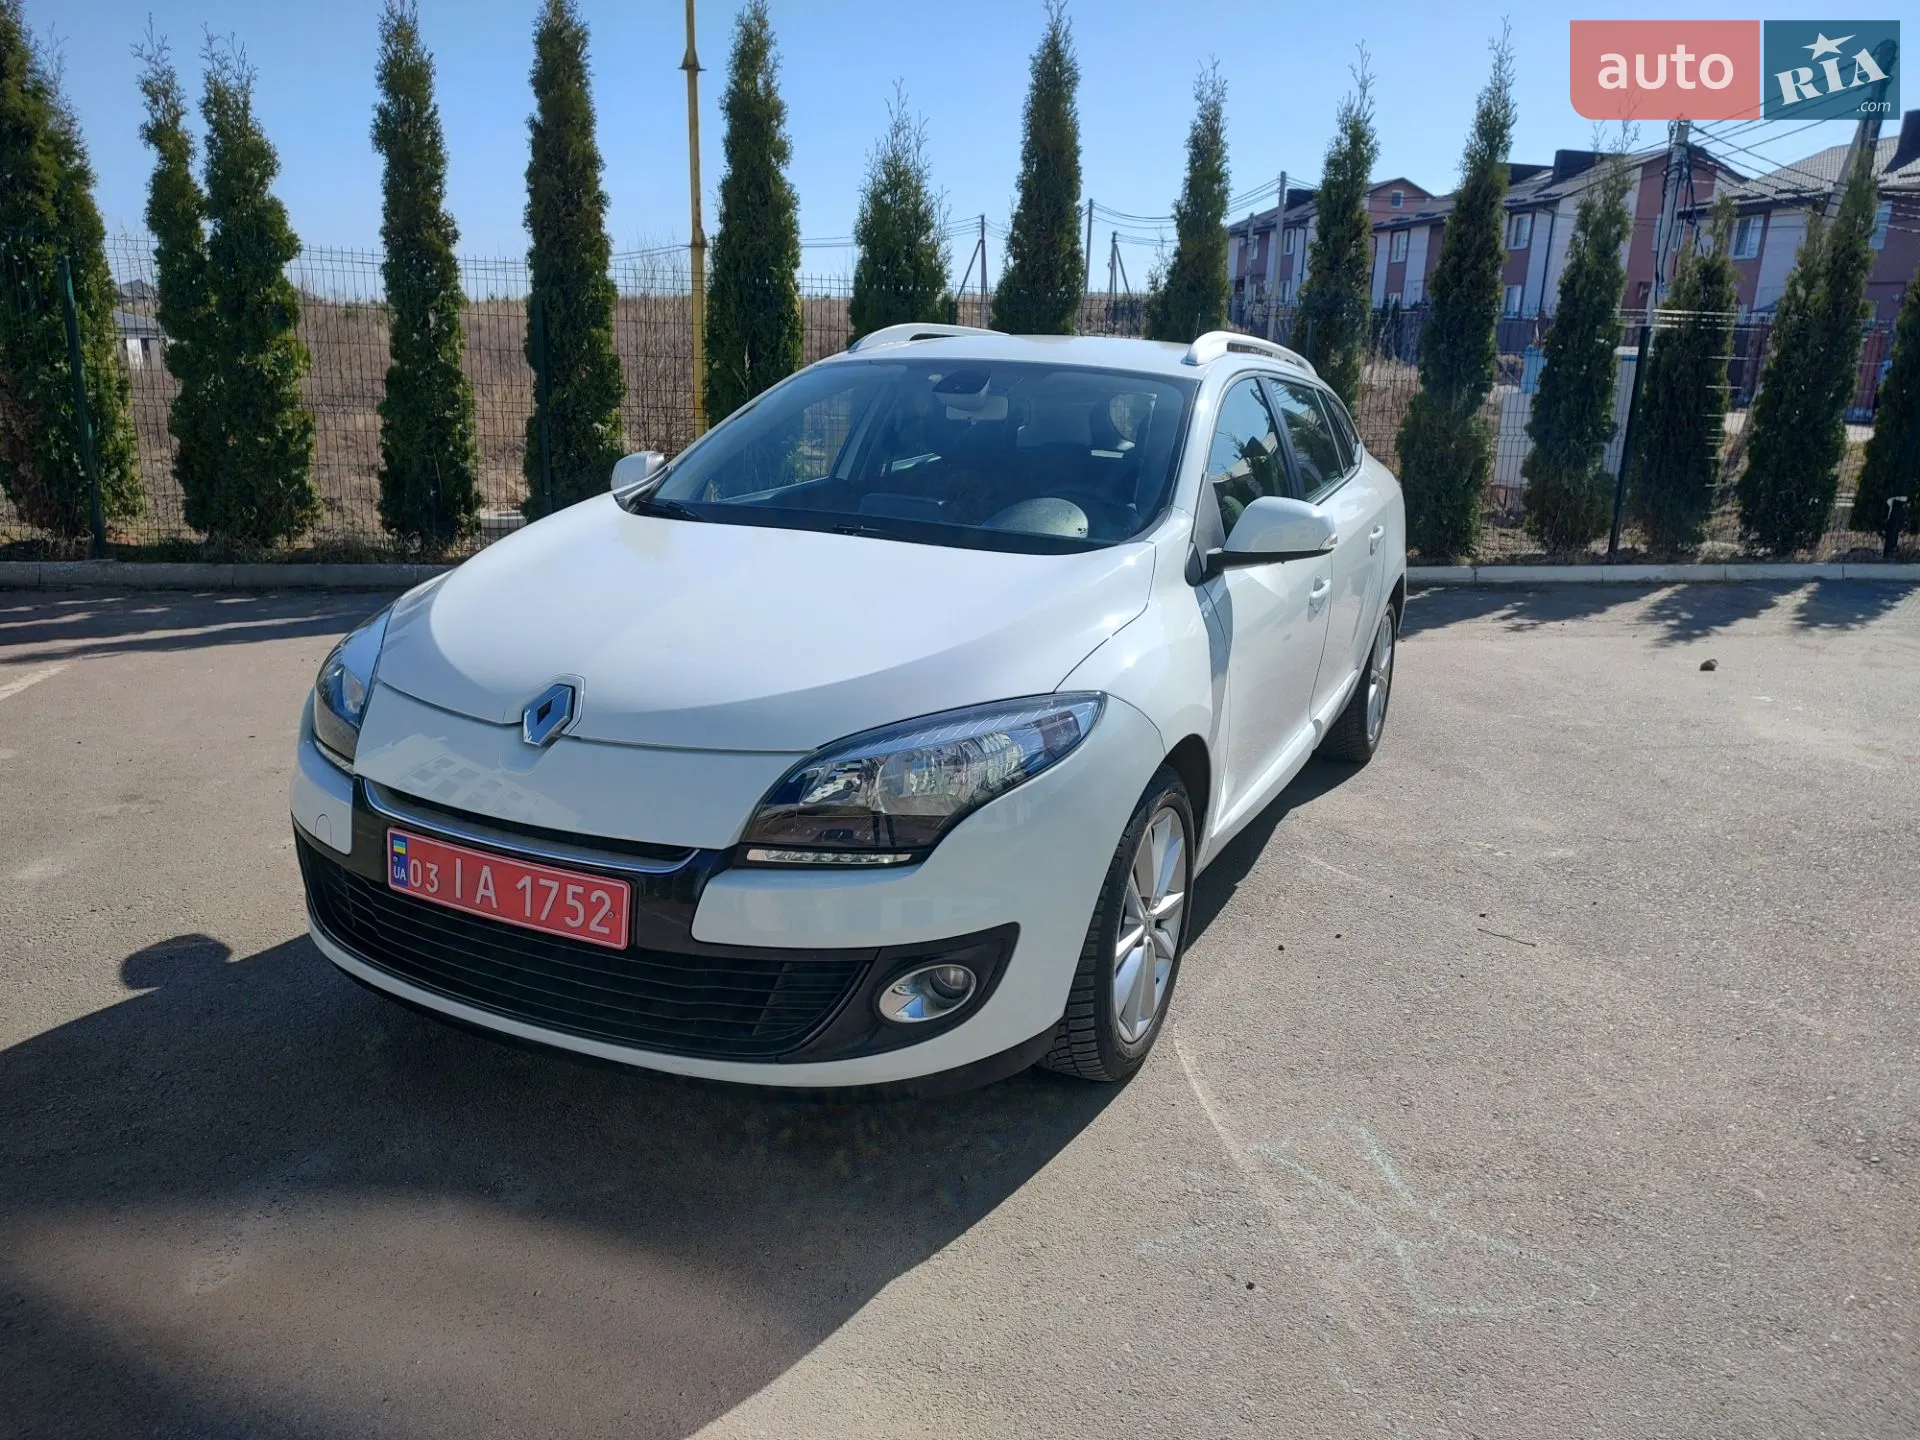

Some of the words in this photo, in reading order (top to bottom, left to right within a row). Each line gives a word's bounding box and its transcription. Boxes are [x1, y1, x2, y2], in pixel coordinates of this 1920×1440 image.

[393, 865, 407, 881] UA
[409, 858, 439, 894] 03
[455, 857, 498, 909] IA
[515, 874, 612, 935] 1752
